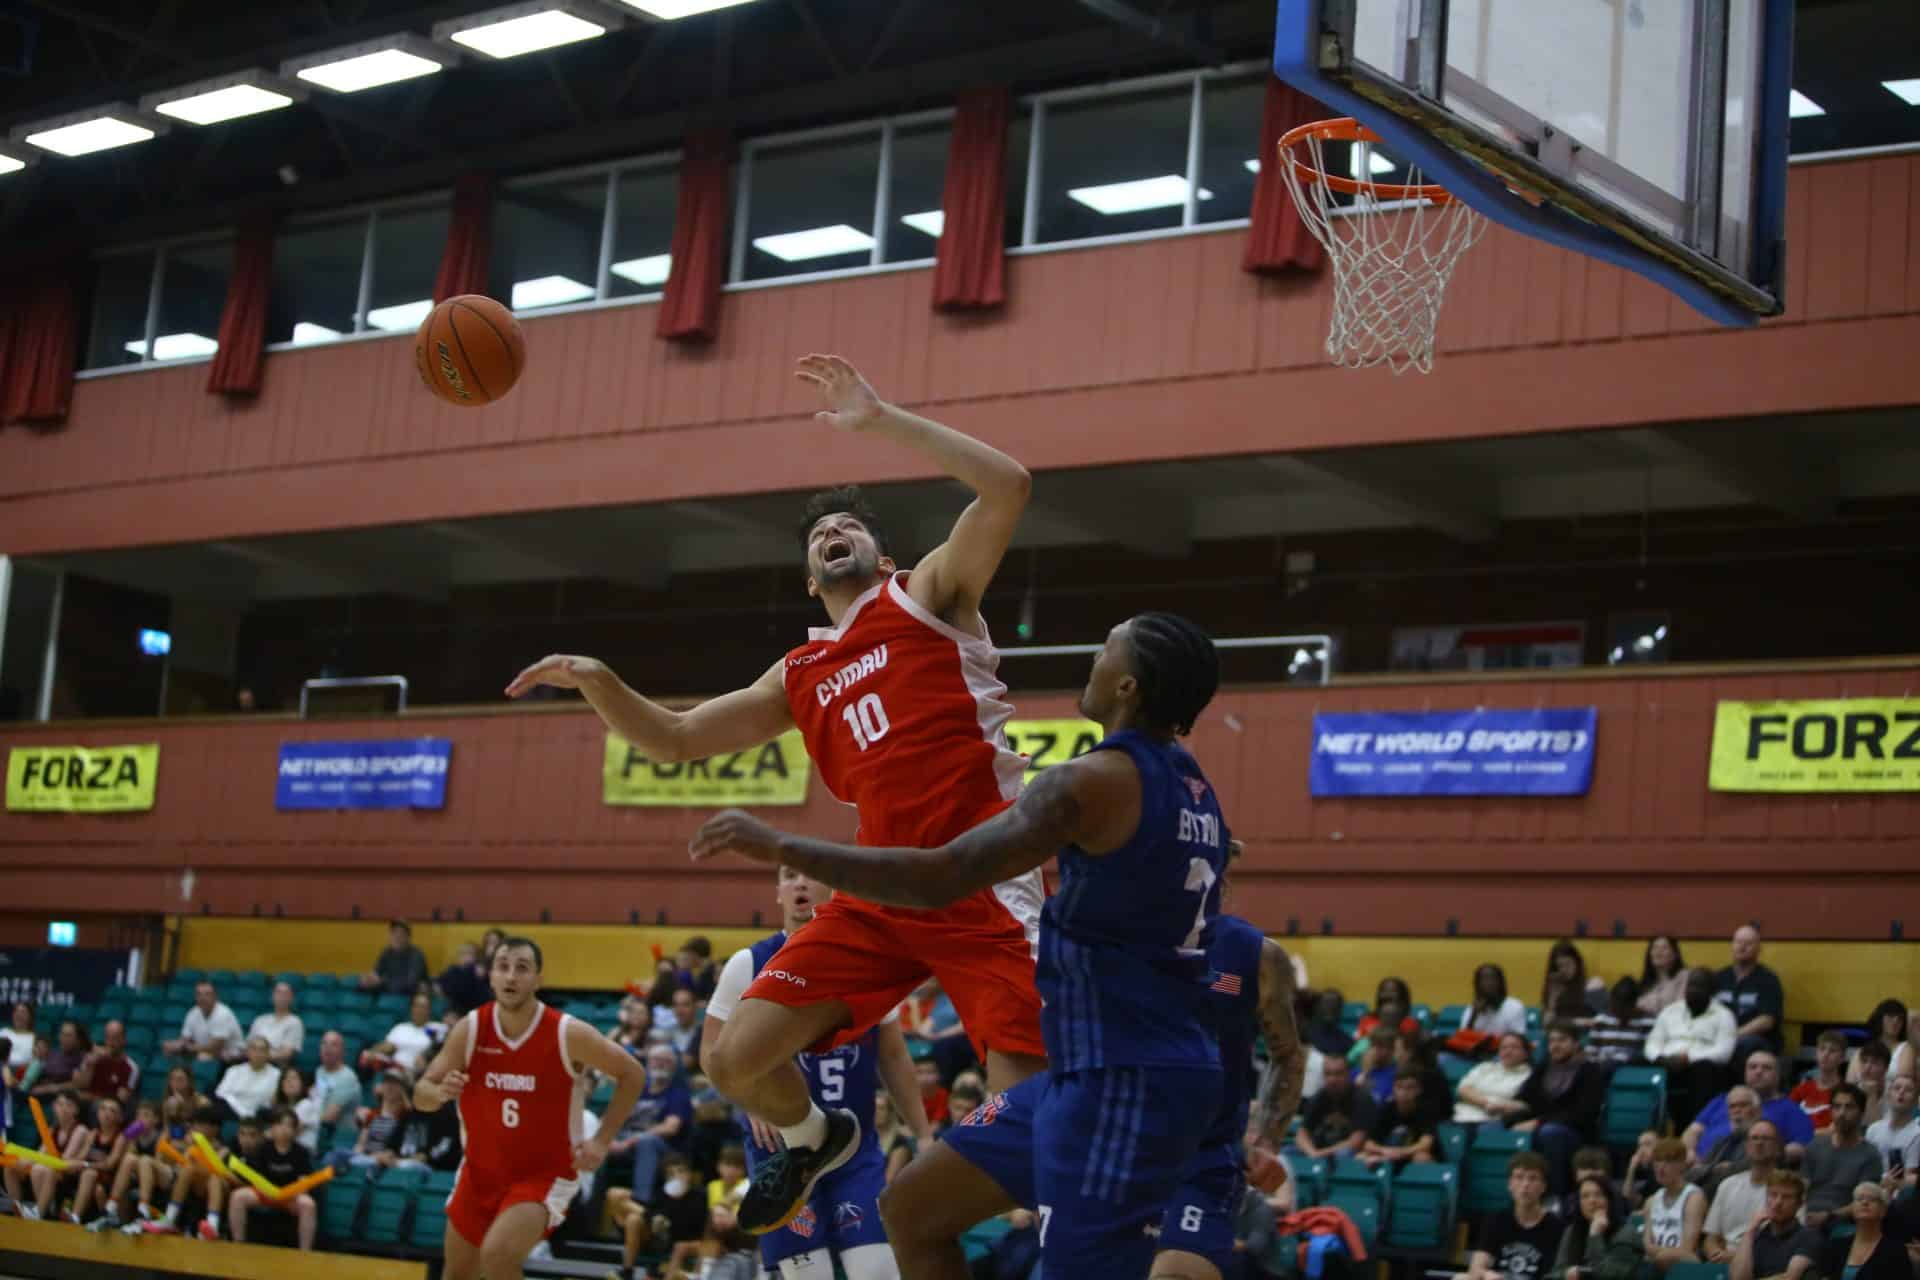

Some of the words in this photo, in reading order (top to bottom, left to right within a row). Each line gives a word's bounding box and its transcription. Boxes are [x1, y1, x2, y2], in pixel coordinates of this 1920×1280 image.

[816, 643, 888, 707] CYMRU
[843, 692, 890, 752] 10
[1375, 731, 1466, 754] WORLD
[22, 755, 139, 789] FORZA
[485, 1071, 537, 1091] CYMRU
[819, 1058, 845, 1101] 5
[502, 1099, 519, 1128] 6
[1180, 1205, 1203, 1233] 8
